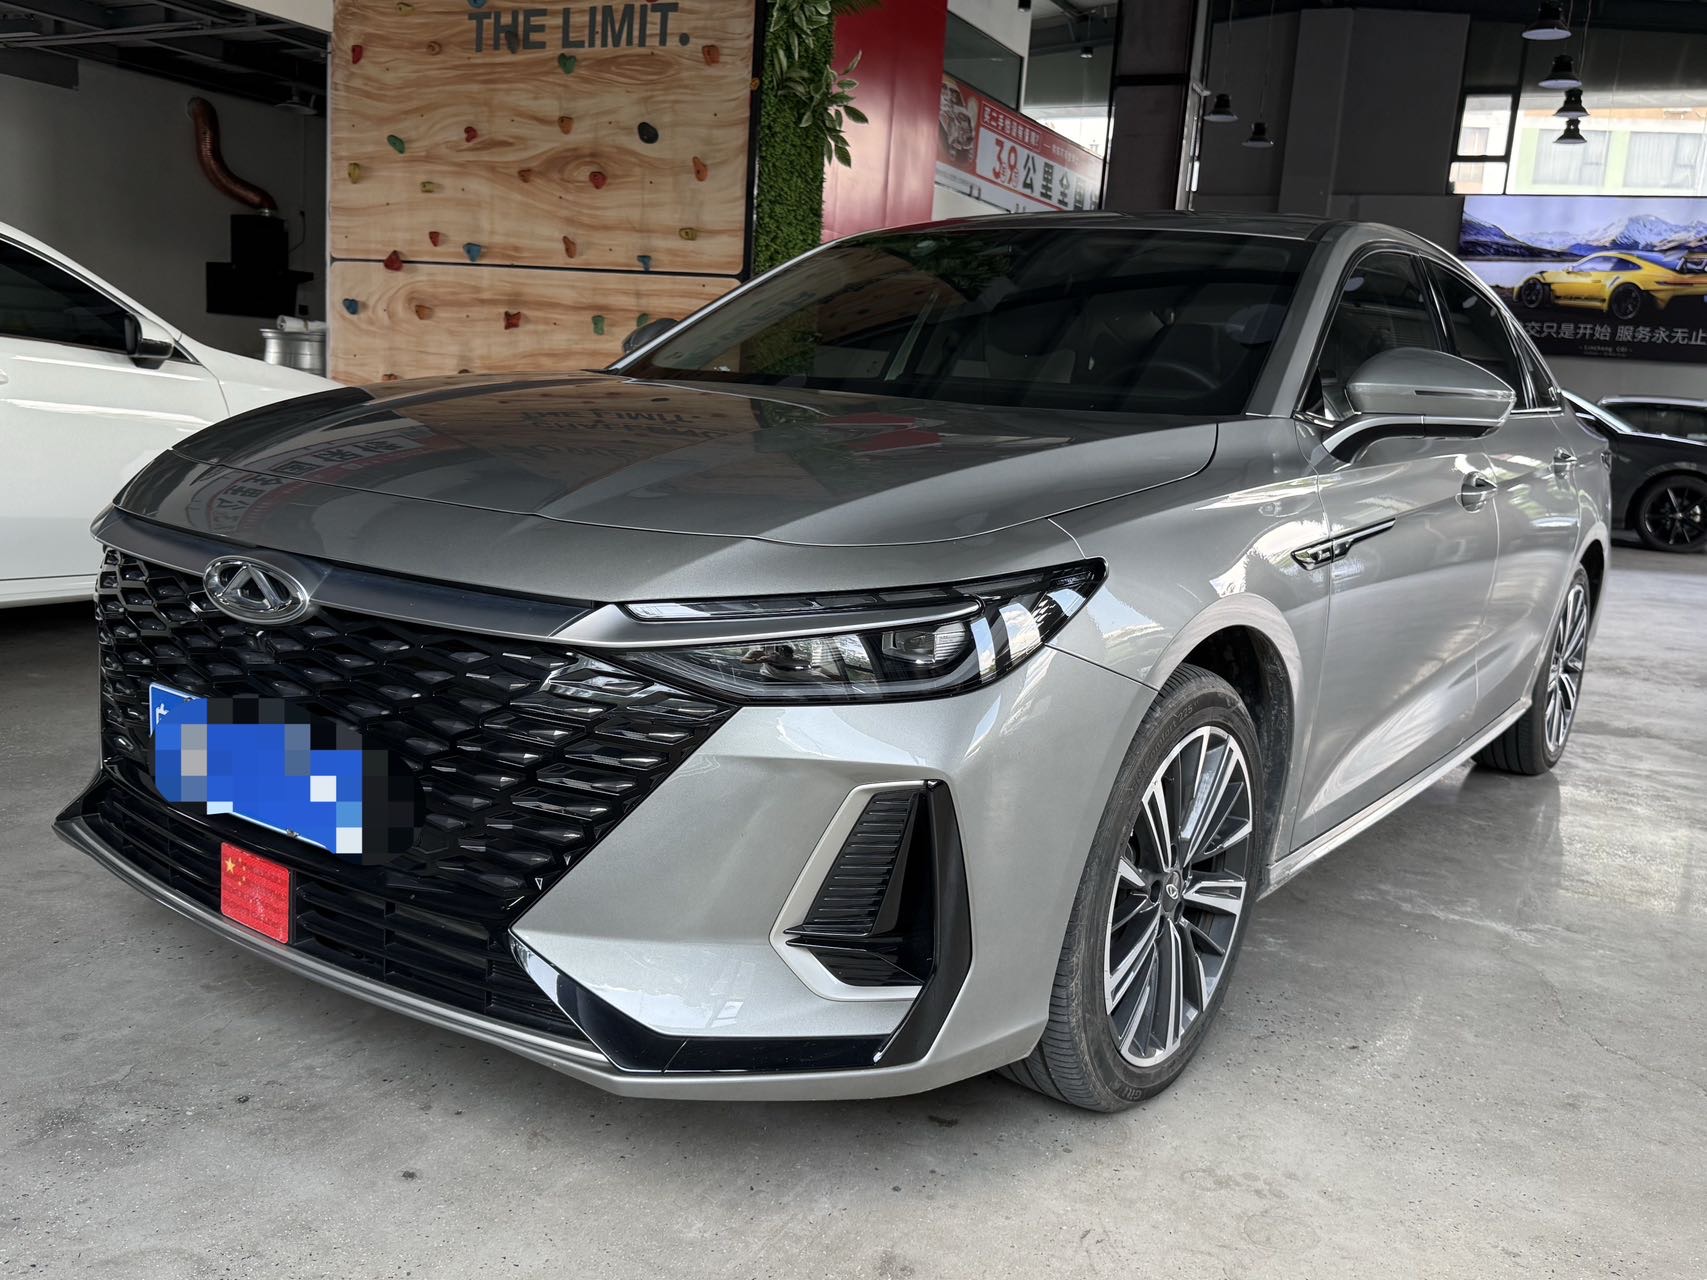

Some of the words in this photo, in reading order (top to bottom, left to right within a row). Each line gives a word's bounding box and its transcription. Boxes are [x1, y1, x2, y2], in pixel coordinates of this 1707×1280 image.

[467, 9, 548, 53] THE
[561, 2, 691, 49] LIMIT.
[1520, 322, 1612, 341] 交只是开始
